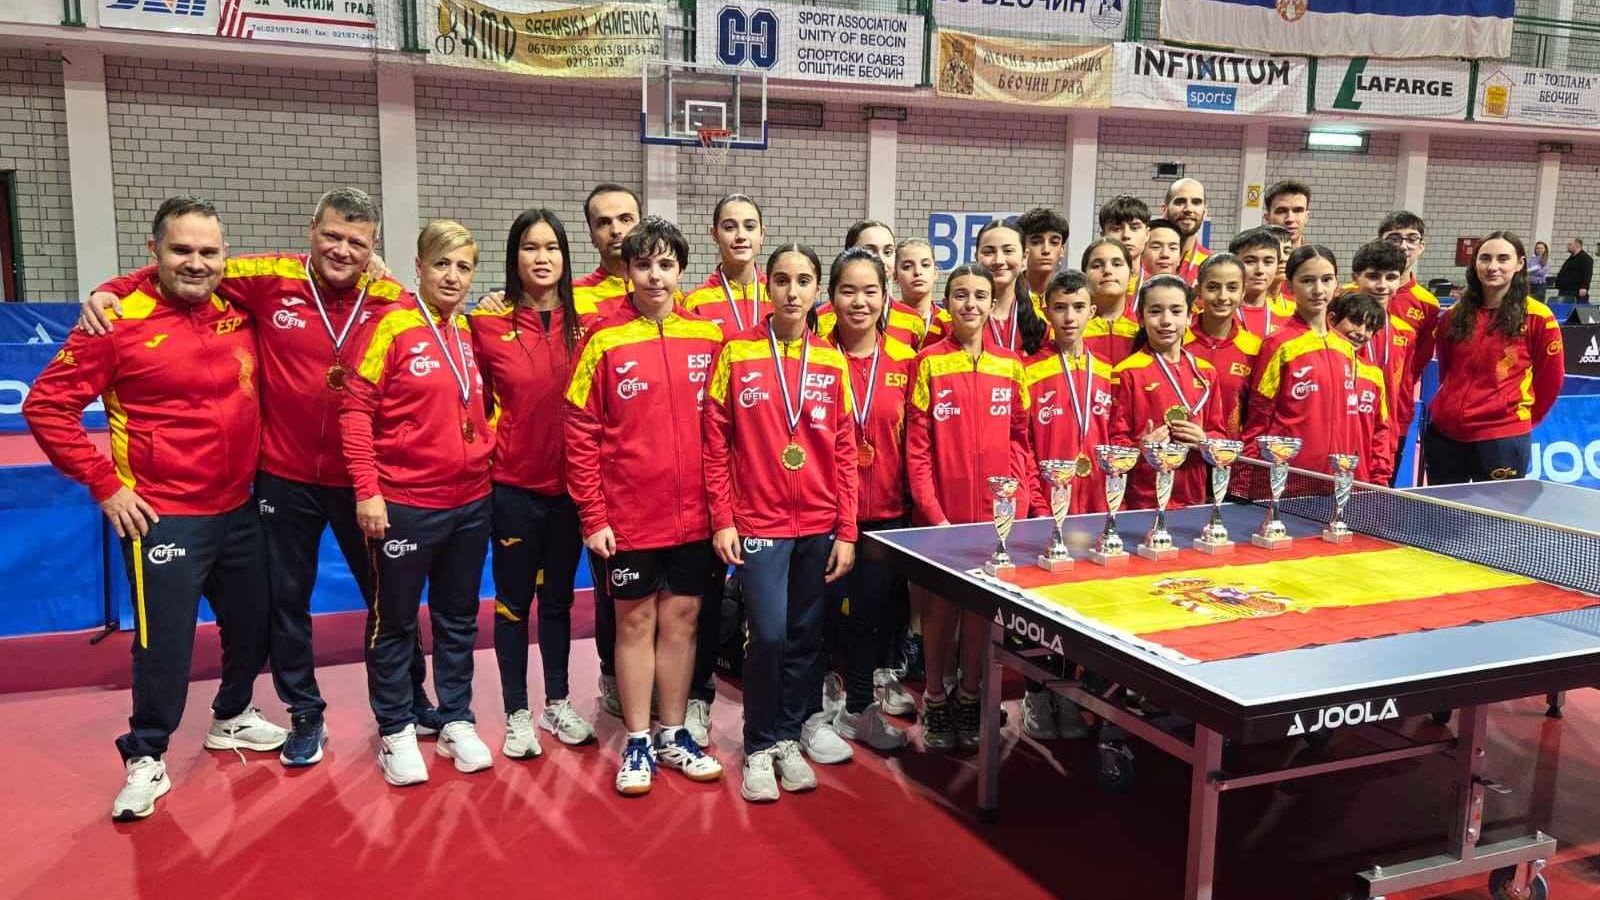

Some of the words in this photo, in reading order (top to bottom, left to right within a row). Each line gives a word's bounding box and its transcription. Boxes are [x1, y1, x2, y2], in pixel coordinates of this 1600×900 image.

[345, 2, 375, 15] ГРАД
[525, 15, 588, 36] SREMSKA
[594, 11, 661, 36] KAMENICA
[799, 12, 836, 26] SPORT
[837, 15, 907, 33] ASSOCIATION
[799, 29, 836, 43] UNITY
[839, 32, 857, 46] OF
[860, 34, 906, 48] BEOCIN
[797, 48, 863, 64] СПОРТСКИ
[866, 53, 905, 67] САВЕЗ
[1134, 46, 1290, 86] INFINITUM
[798, 61, 856, 77] ОПШТИНЕ
[858, 65, 904, 80] БЕОЧИН
[998, 74, 1049, 93] БЕОЧИН
[1356, 75, 1453, 97] LAFARGE
[1190, 88, 1232, 106] sports
[1539, 90, 1580, 105] БЕОЧИН
[215, 316, 242, 335] ESP
[687, 354, 711, 368] ESP
[1230, 362, 1251, 377] ESP
[805, 373, 835, 388] ESP
[885, 372, 909, 387] ESP
[1006, 613, 1065, 656] JOOLA
[1310, 698, 1399, 733] JOOLA
